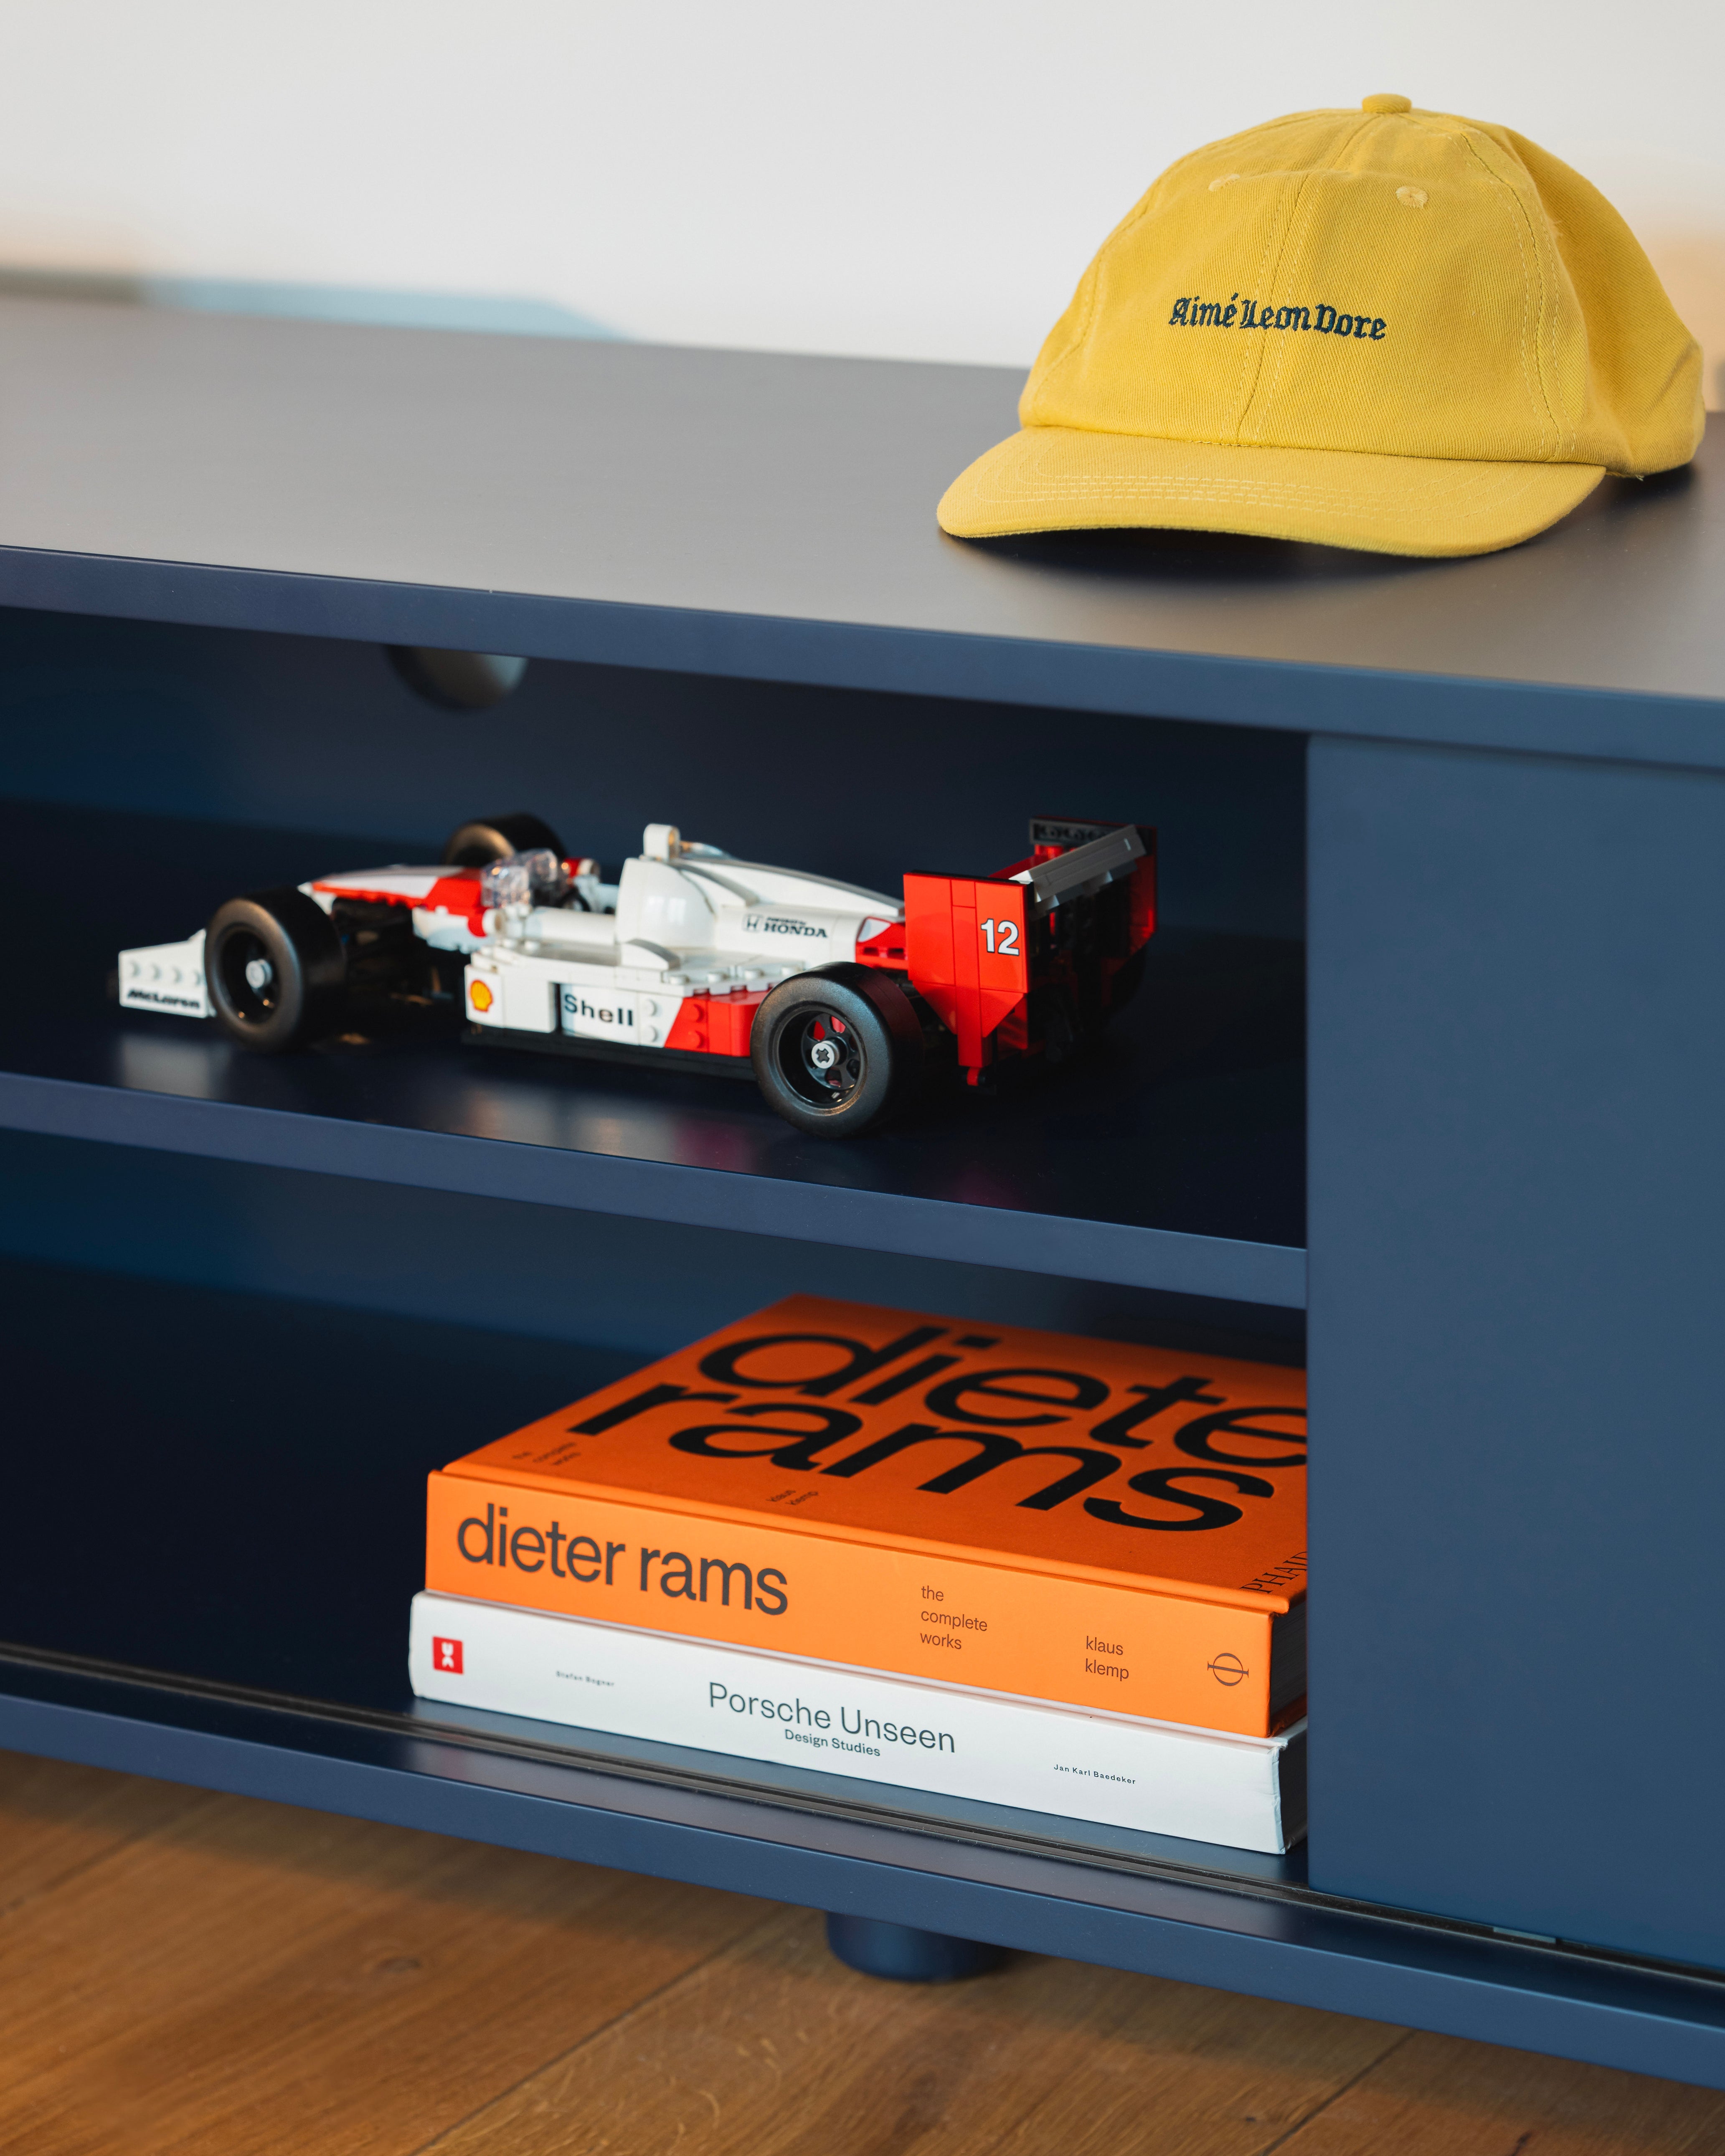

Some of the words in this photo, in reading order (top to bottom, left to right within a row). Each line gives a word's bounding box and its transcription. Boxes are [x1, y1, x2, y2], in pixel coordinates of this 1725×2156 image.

[1169, 293, 1238, 328] Aimé
[1239, 299, 1312, 331] Leon
[1314, 304, 1387, 340] Dore
[765, 923, 827, 937] HONDA
[981, 918, 1020, 956] 12
[564, 994, 632, 1026] Shell
[566, 1382, 1275, 1531] rams
[458, 1504, 625, 1585] dieter
[641, 1548, 787, 1615] rams
[921, 1585, 944, 1601] the
[921, 1611, 987, 1631] complete
[921, 1633, 961, 1649] works
[1086, 1636, 1123, 1655] klaus
[1086, 1659, 1129, 1681] klemp
[710, 1682, 830, 1728] Porsche
[842, 1707, 954, 1753] Unseen
[785, 1729, 828, 1747] Design
[832, 1738, 880, 1756] Studies
[1094, 1771, 1135, 1784] Baedeker
